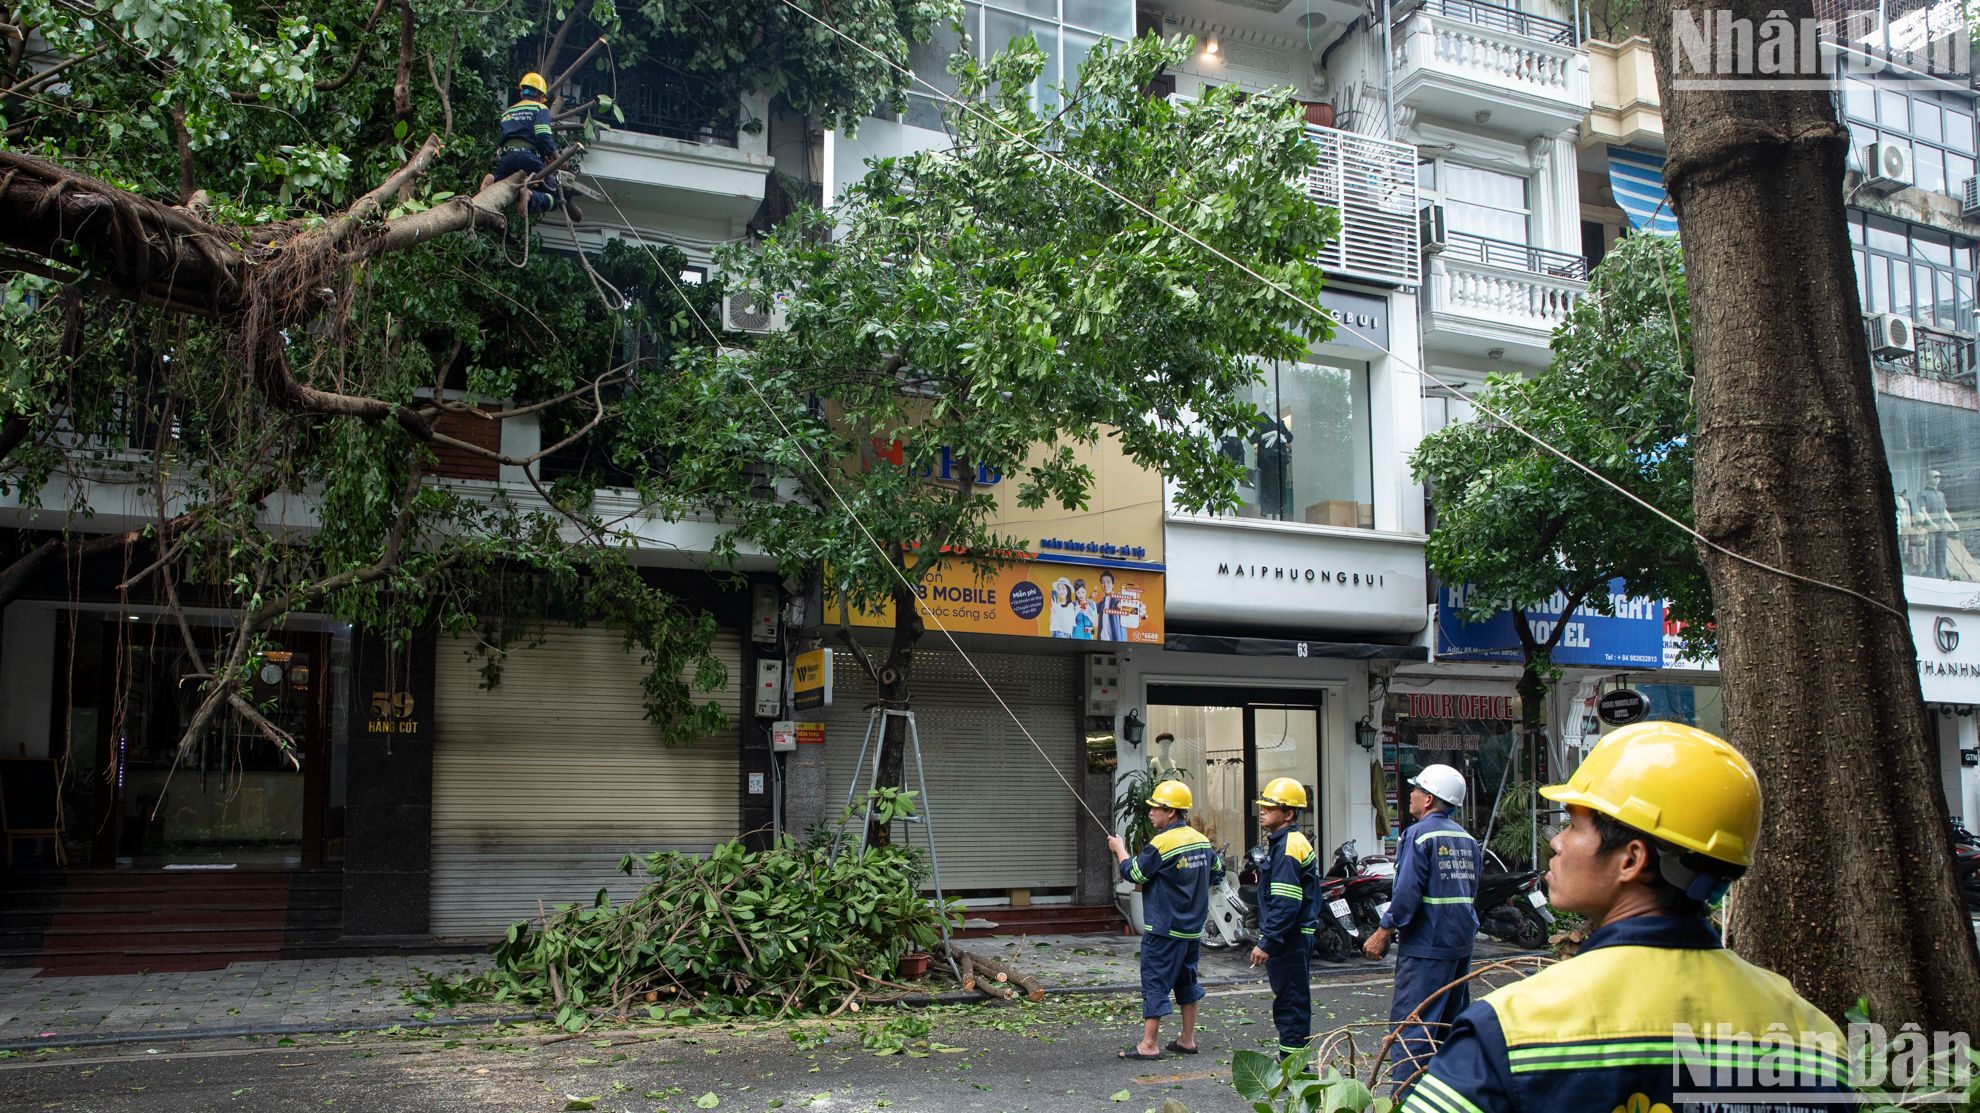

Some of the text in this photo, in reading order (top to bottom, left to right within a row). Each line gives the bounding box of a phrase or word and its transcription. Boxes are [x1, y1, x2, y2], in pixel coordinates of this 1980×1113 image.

[933, 586, 996, 605] MOBILE
[1528, 588, 1655, 620] ONGHT
[921, 605, 996, 622] cuộc sống số
[1297, 642, 1308, 658] 63
[370, 691, 414, 718] 59
[1408, 693, 1514, 720] TOUR OFFICE
[368, 718, 418, 733] HÀNG CÓT
